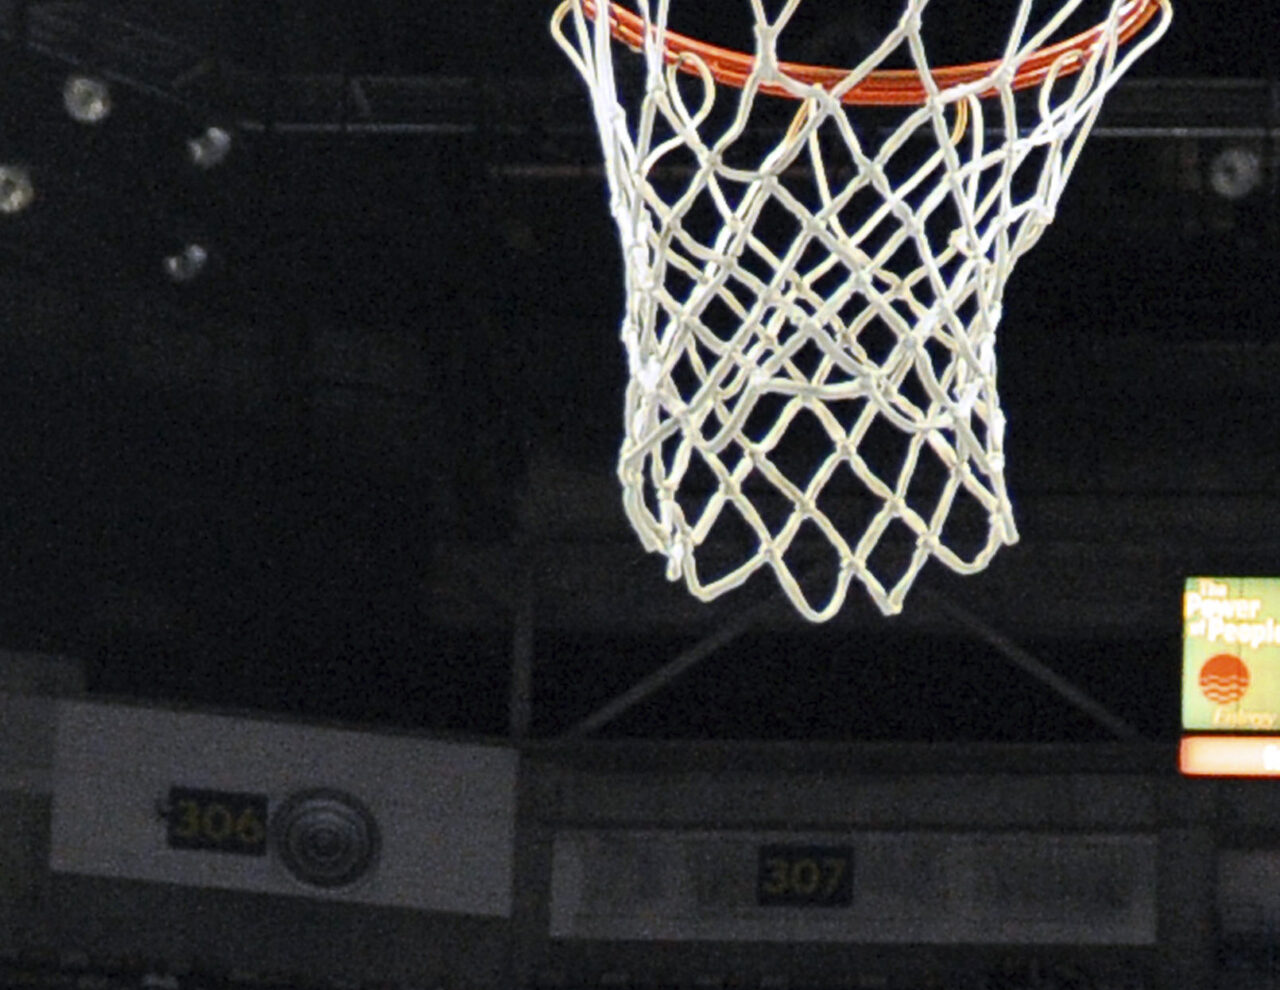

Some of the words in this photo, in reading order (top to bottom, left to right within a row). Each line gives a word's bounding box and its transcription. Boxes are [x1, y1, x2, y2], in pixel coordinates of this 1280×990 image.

[1185, 591, 1262, 620] Power
[173, 799, 266, 843] 306
[763, 857, 847, 897] 307
